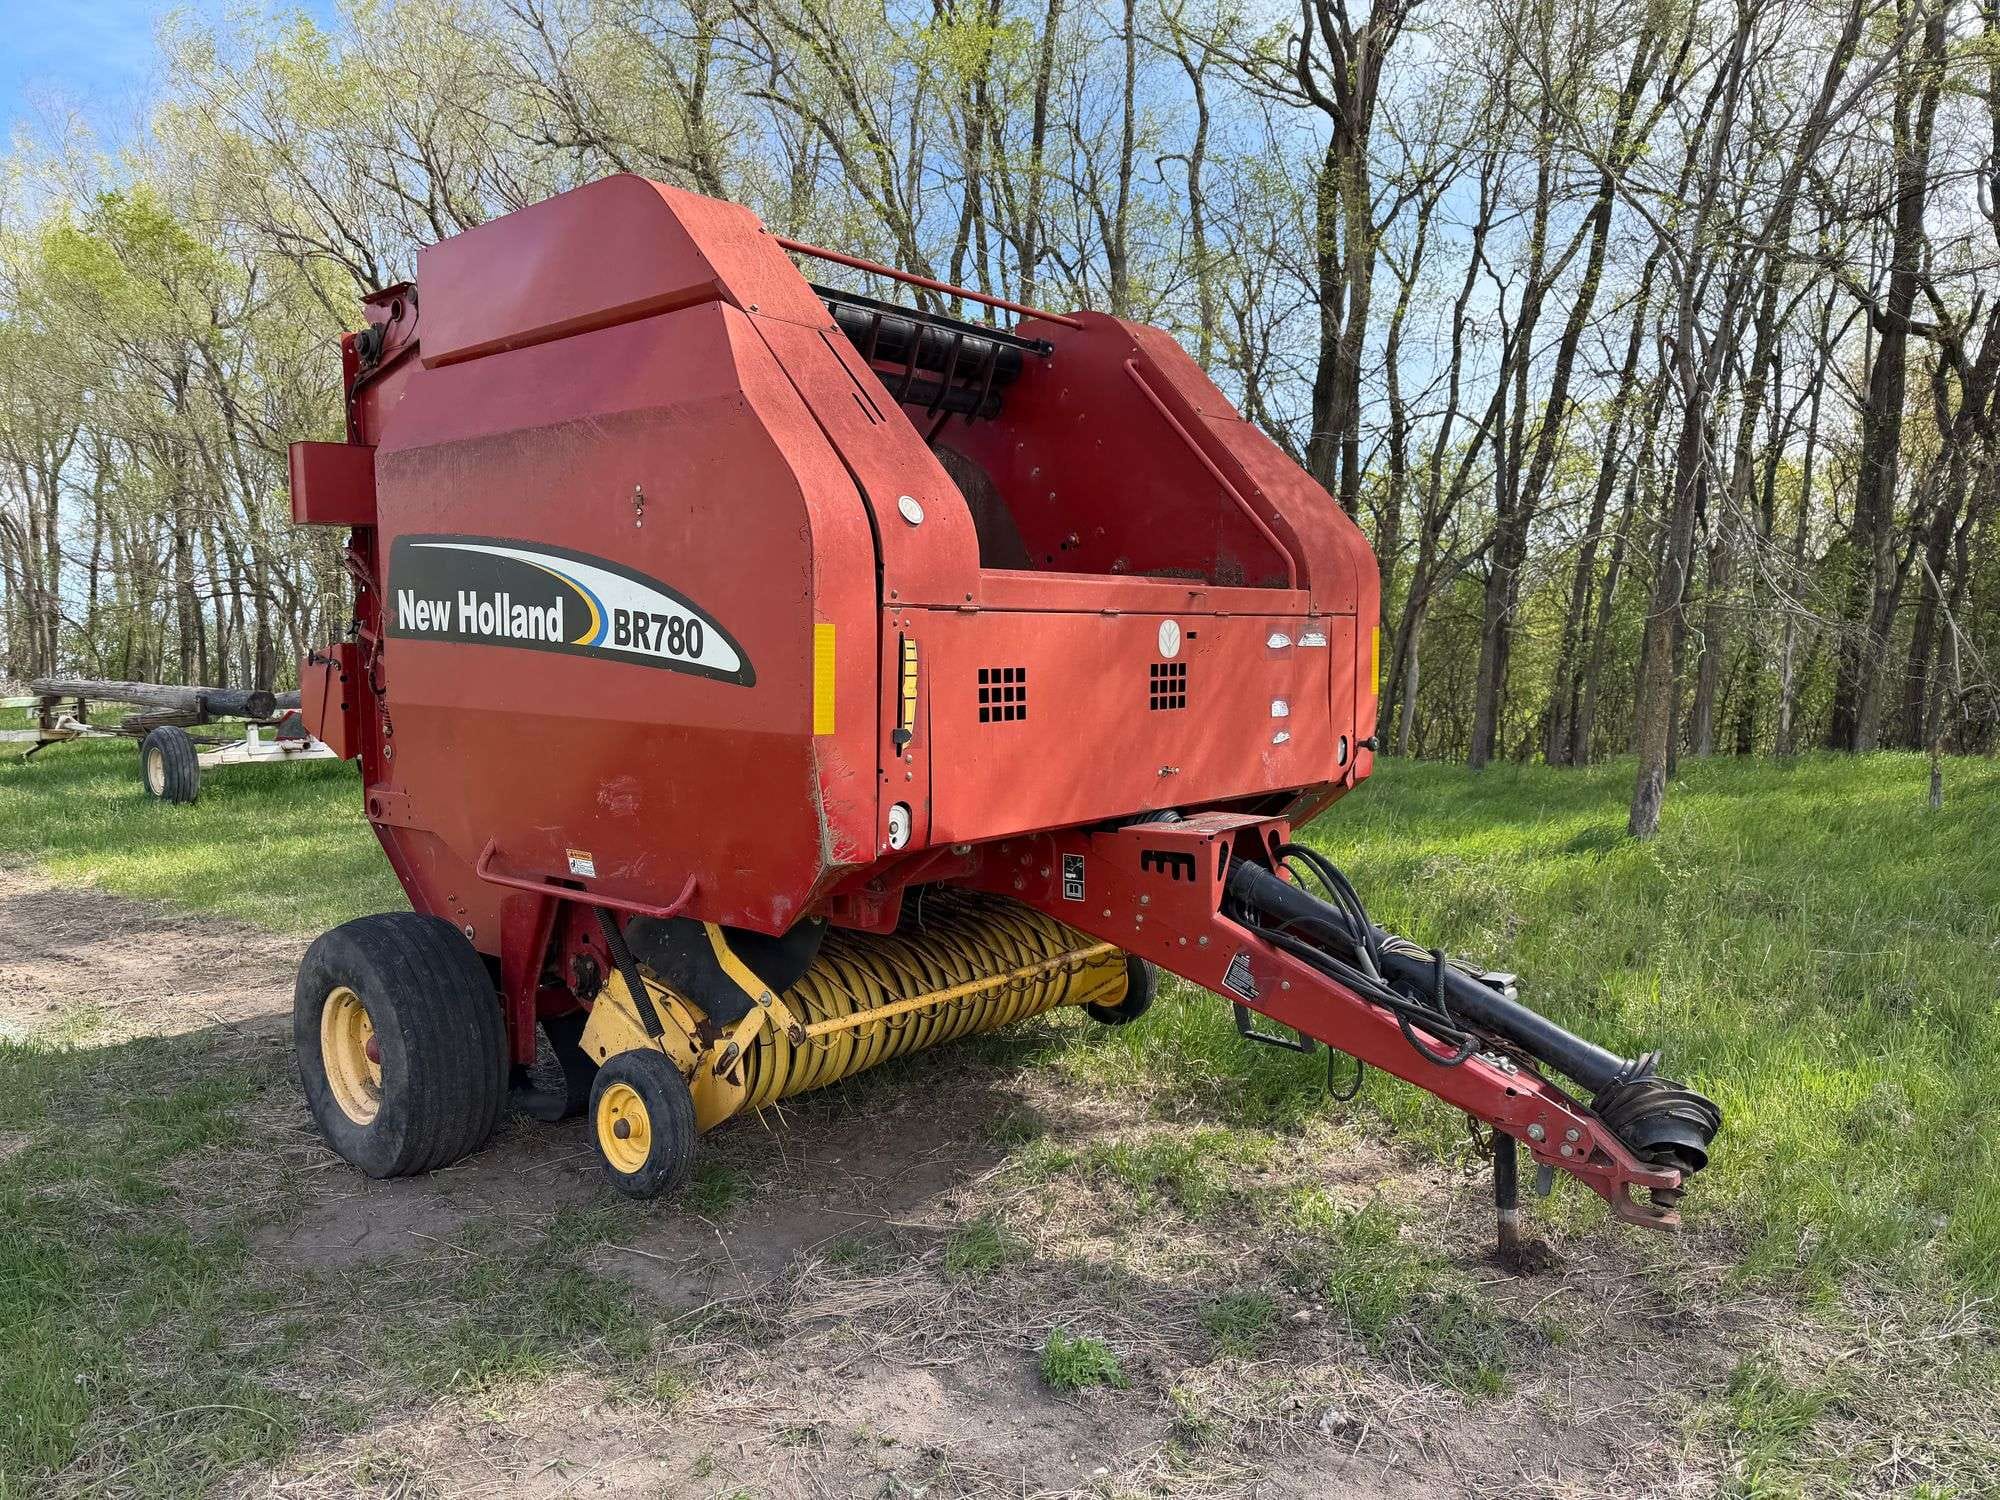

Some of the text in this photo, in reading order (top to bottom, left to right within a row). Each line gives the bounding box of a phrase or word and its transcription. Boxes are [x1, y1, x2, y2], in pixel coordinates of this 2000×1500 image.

[398, 589, 703, 658] New Holland BR780
